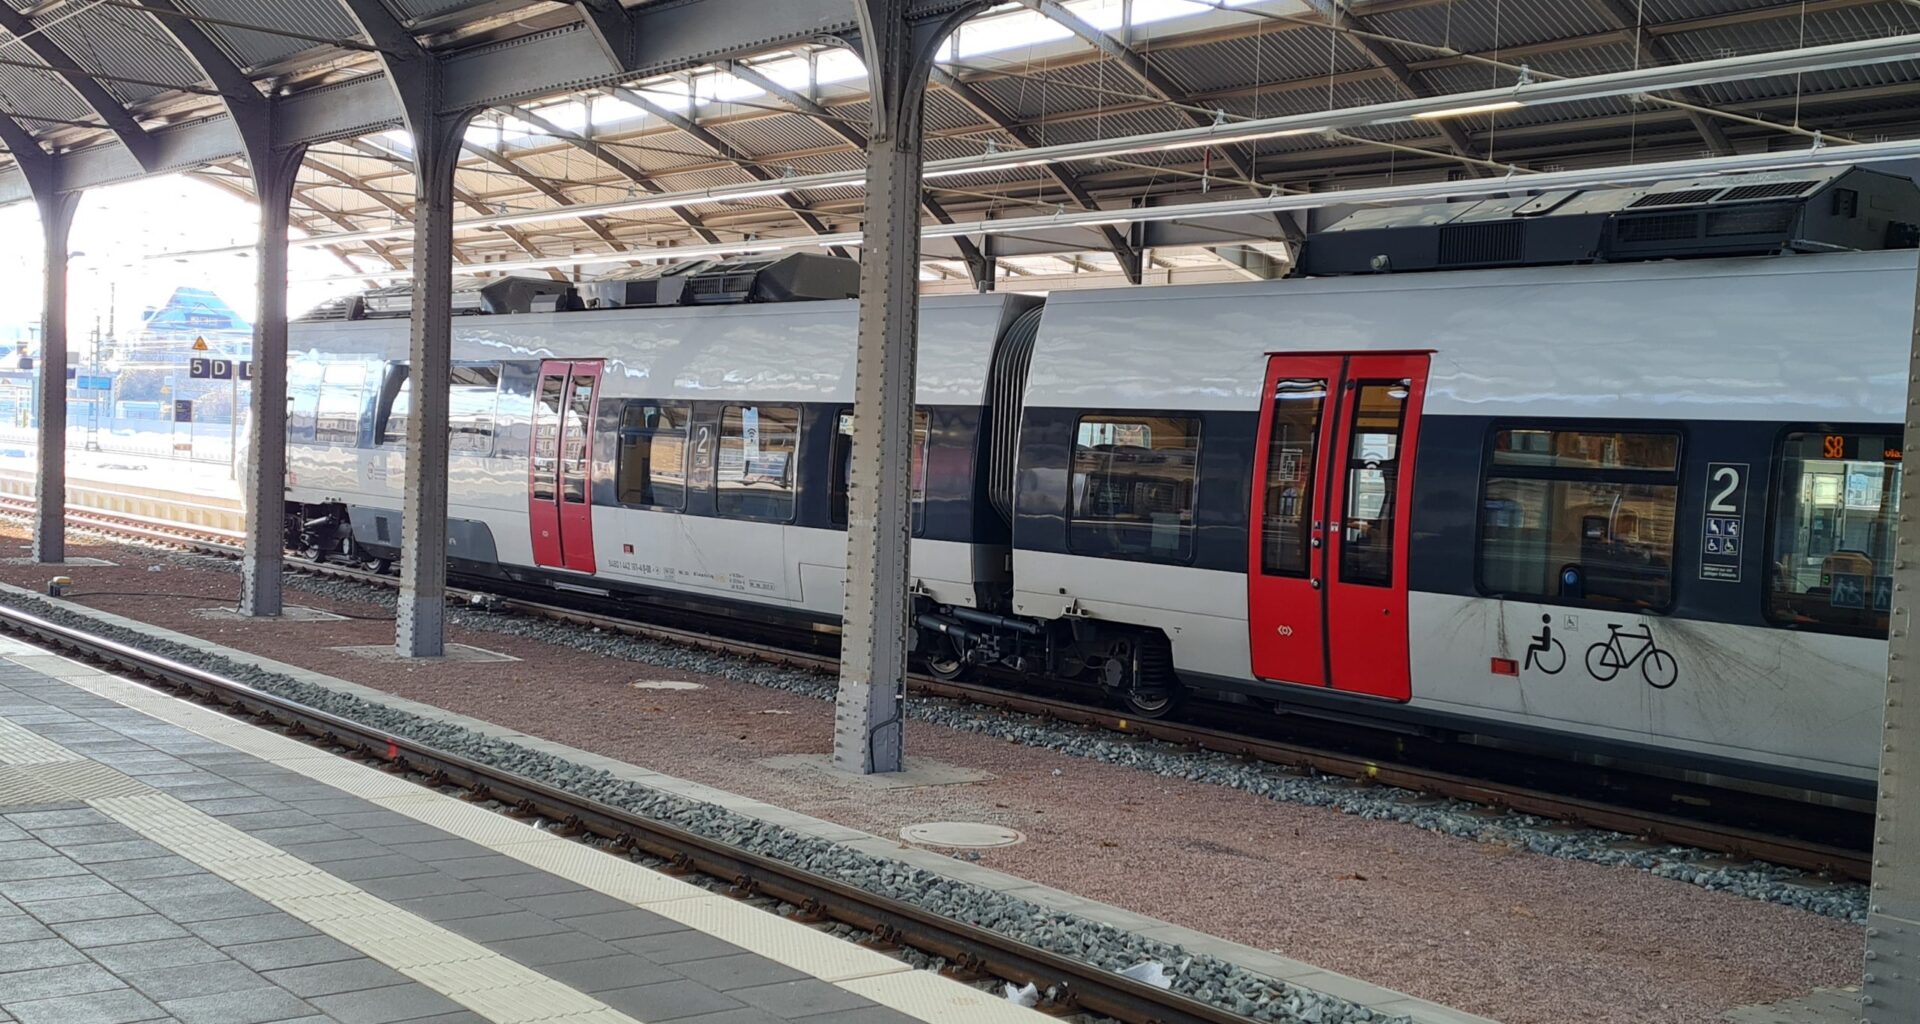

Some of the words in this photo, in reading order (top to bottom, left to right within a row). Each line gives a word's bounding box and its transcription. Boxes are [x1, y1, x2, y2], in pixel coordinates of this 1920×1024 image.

[193, 360, 202, 374] 5
[214, 361, 226, 376] D
[697, 426, 708, 453] 2
[1824, 435, 1844, 458] S8
[1710, 467, 1740, 512] 2
